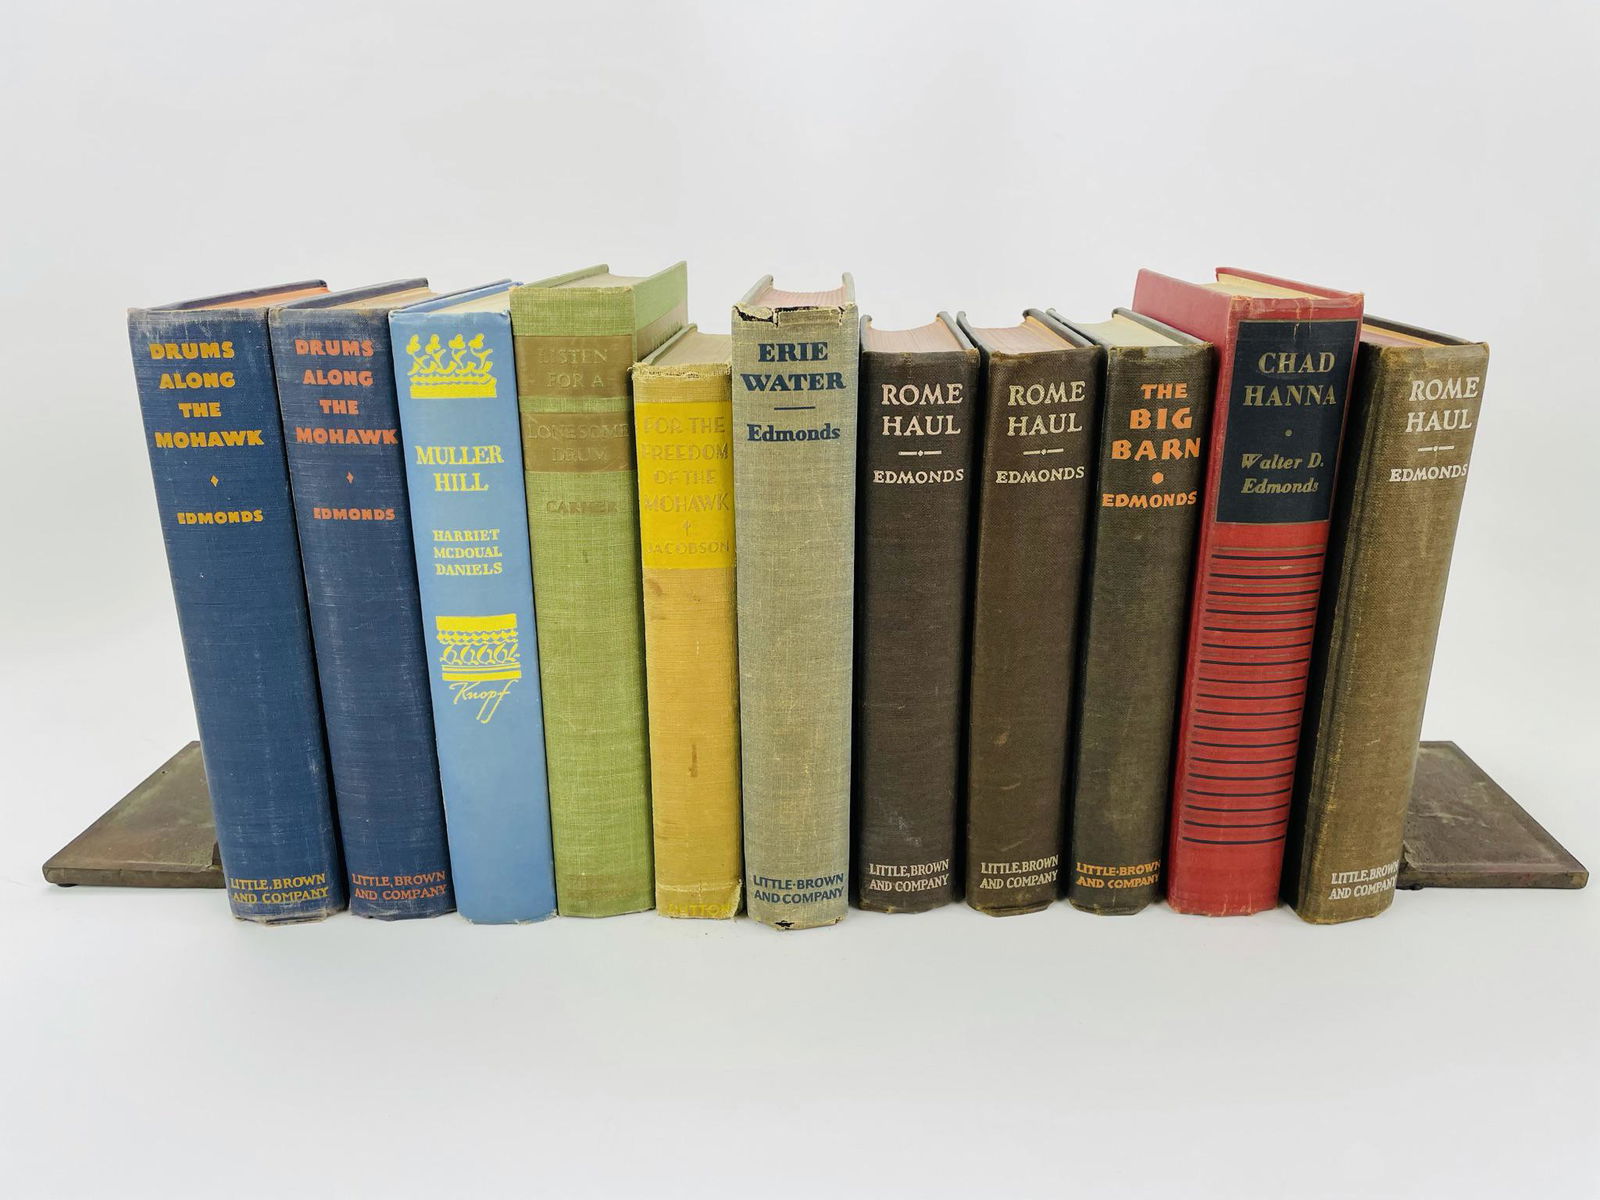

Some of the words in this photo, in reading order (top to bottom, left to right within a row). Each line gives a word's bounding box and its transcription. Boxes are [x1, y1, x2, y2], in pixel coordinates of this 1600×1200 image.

[150, 341, 235, 359] DRUMS
[295, 339, 374, 357] DRUMS
[758, 341, 828, 363] ERIE
[1258, 351, 1336, 374] CHAD
[159, 371, 235, 389] ALONG
[303, 369, 373, 386] ALONG
[546, 372, 584, 388] FOR
[592, 375, 604, 388] A
[740, 372, 847, 392] WATER
[881, 383, 963, 406] ROME
[1008, 381, 1086, 406] ROME
[1141, 383, 1189, 400] THE
[1243, 385, 1336, 407] HANNA
[1409, 376, 1480, 402] ROME
[178, 402, 221, 418] THE
[320, 399, 359, 415] THE
[643, 416, 683, 434] FOR
[688, 416, 726, 434] THE
[882, 415, 961, 436] HAUL
[1007, 413, 1083, 437] HAUL
[1129, 408, 1193, 430] BIG
[1405, 408, 1473, 433] HAUL
[155, 430, 264, 448] MOHAWK
[295, 427, 398, 445] MOHAWK
[527, 423, 629, 440] LONESOME
[747, 423, 841, 442] Edmonds
[415, 445, 504, 465] MULLER
[641, 443, 729, 460] FREEDOM
[1111, 437, 1201, 461] BARN
[1241, 453, 1303, 470] Walter
[1308, 452, 1324, 468] D.
[653, 470, 679, 485] OF
[682, 469, 717, 485] THE
[873, 468, 964, 485] EDMONDS
[996, 466, 1085, 484] EDMONDS
[1389, 463, 1468, 482] EDMONDS
[433, 472, 489, 492] HILL
[1241, 477, 1319, 494] Edmonds
[643, 492, 730, 513] MOHAWK
[1102, 490, 1197, 508] EDMONDS
[177, 510, 263, 525] EDMONDS
[313, 507, 395, 521] EDMONDS
[432, 528, 500, 541] HARRIET
[433, 546, 502, 559] MCDOUAL
[435, 562, 503, 576] DANIELS
[449, 679, 519, 724] Knopf
[869, 876, 892, 891] AND
[895, 874, 949, 893] COMPANY
[979, 875, 1004, 890] AND
[1006, 870, 1058, 889] COMPANY
[1076, 875, 1105, 889] AND
[1107, 873, 1160, 889] COMPANY
[1329, 887, 1351, 900] AND
[1353, 876, 1398, 896] COMPANY
[233, 893, 257, 903] AND
[262, 887, 328, 903] COMPANY
[355, 887, 377, 900] AND
[382, 885, 447, 900] COMPANY
[754, 890, 780, 903] AND
[782, 886, 844, 904] COMPANY
